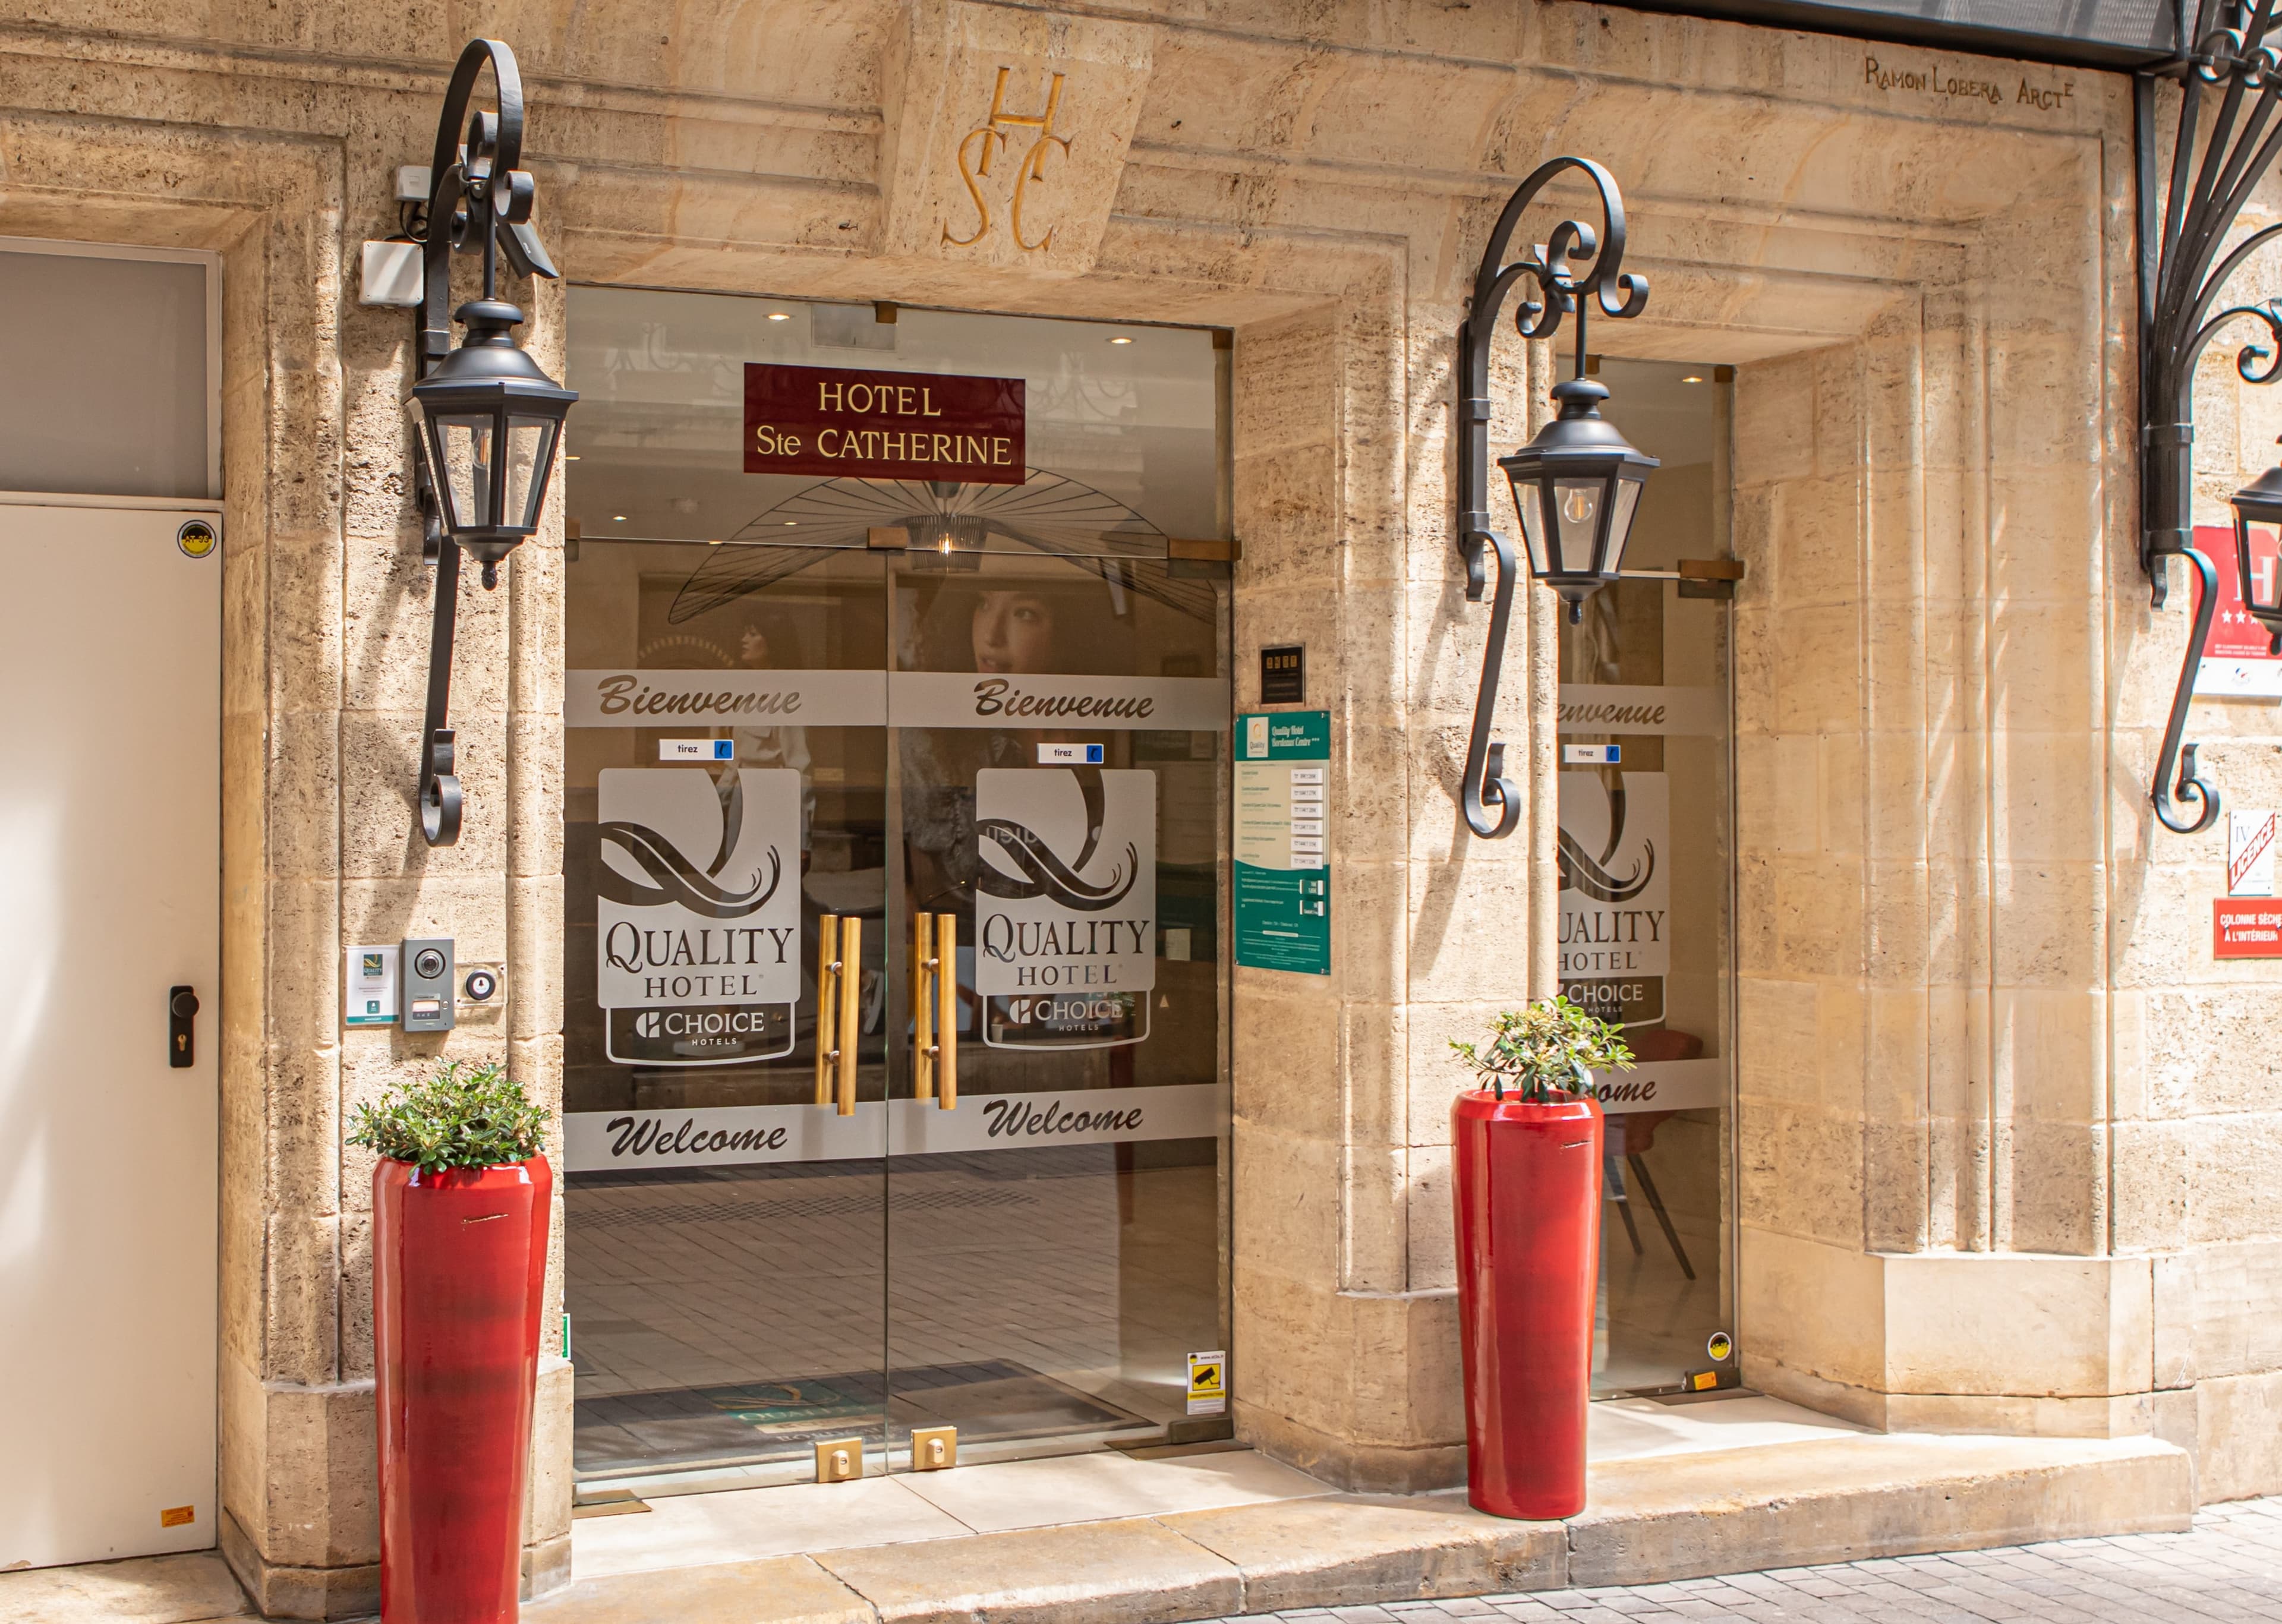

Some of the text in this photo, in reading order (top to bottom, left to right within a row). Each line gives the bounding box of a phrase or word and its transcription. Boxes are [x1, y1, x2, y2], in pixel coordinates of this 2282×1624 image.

[818, 382, 941, 416] HOTEL
[757, 425, 1012, 465] Ste CATHERINE
[597, 674, 802, 714] Bienvenue
[973, 678, 1154, 718] Bienvenue
[1558, 703, 1666, 725] envenue
[677, 744, 698, 753] tirez
[1054, 748, 1072, 757] tirez
[2231, 818, 2275, 887] LICENCE
[1558, 910, 1665, 944] UALITY
[2220, 914, 2256, 926] COLONNE
[606, 922, 795, 973] QUALITY
[983, 913, 1150, 963] QUALITY
[644, 975, 758, 998] HOTEL
[1017, 964, 1117, 986] HOTEL
[1568, 984, 1643, 1003] CHOICE
[665, 1013, 765, 1035] CHOICE
[1035, 999, 1123, 1021] CHOICE
[692, 1038, 737, 1046] HOTELS
[983, 1099, 1143, 1137] Welcome
[606, 1117, 787, 1157] Welcome
